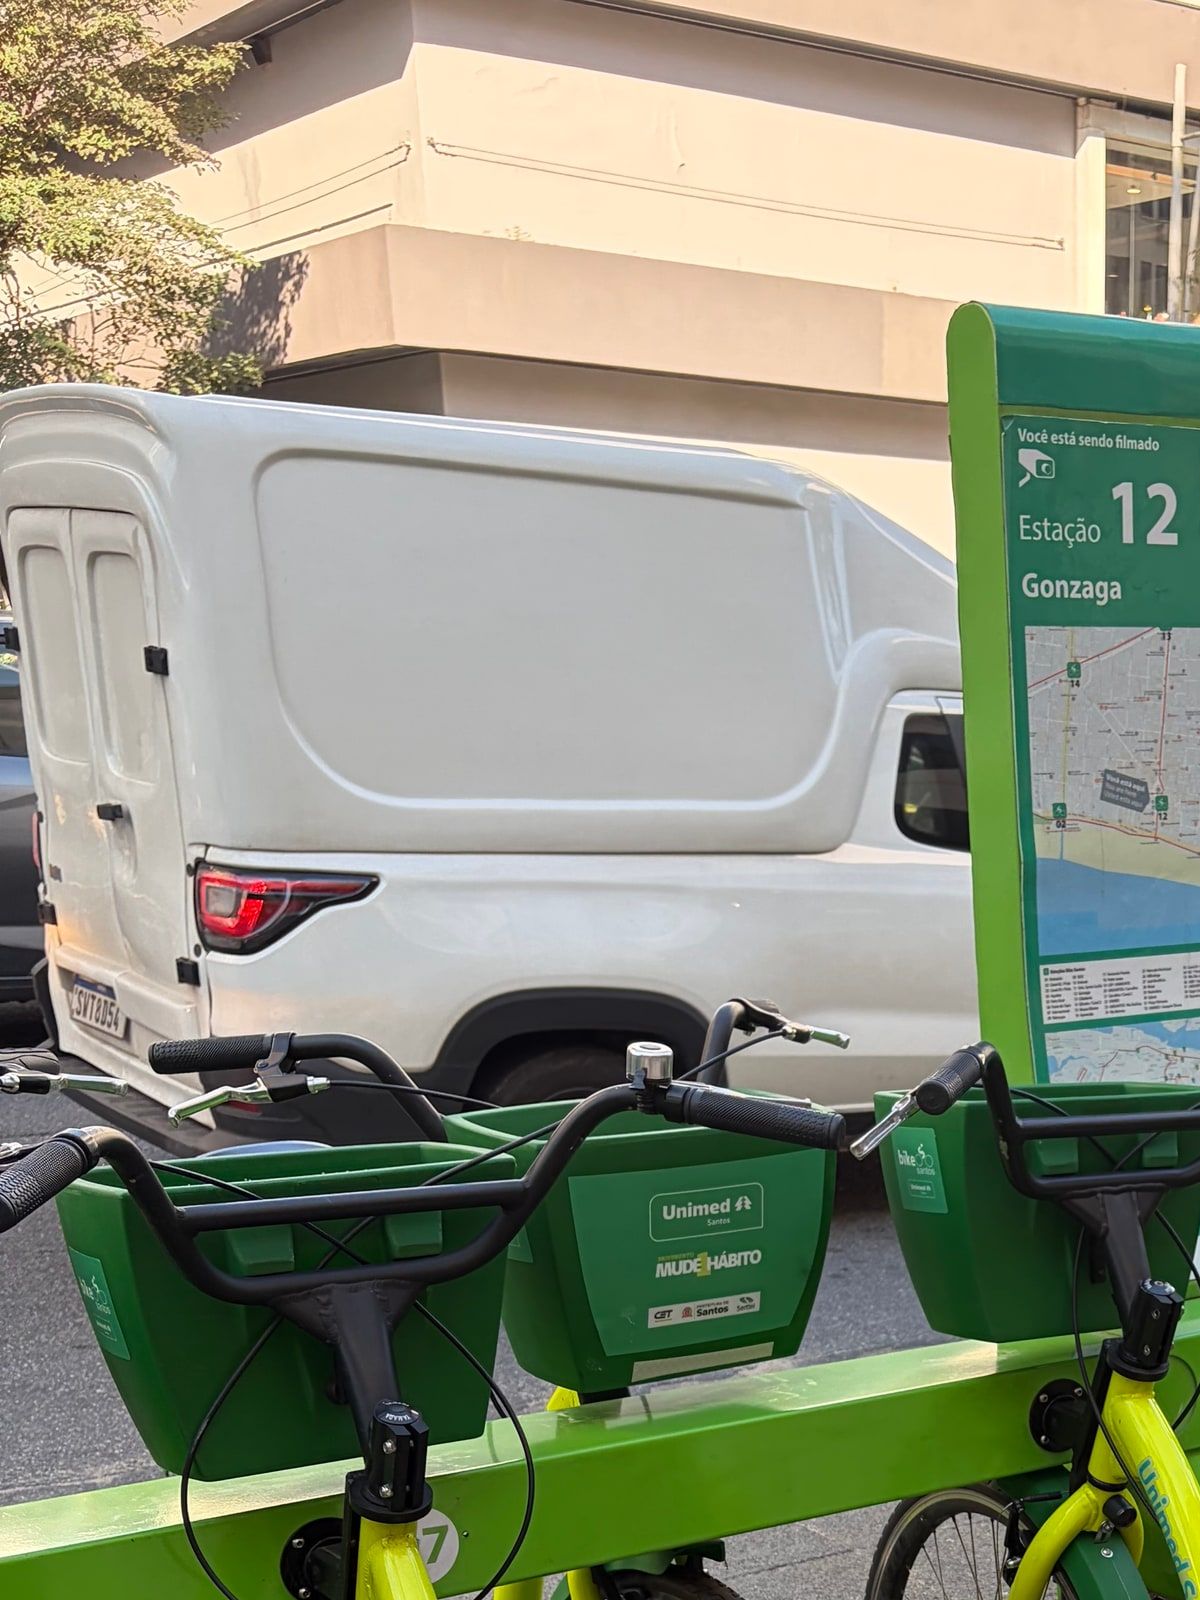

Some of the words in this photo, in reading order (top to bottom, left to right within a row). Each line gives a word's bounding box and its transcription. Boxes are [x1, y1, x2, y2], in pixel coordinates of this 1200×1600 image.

[1018, 428, 1048, 444] Você
[1050, 432, 1076, 446] está
[1078, 434, 1113, 448] sendo
[1115, 435, 1160, 451] filmado
[1112, 482, 1179, 546] 12
[1019, 515, 1101, 549] Estação
[1022, 572, 1122, 606] Gonzaga
[897, 1149, 917, 1167] bike
[662, 1198, 731, 1220] Unimed
[707, 1217, 731, 1227] Santos
[655, 1257, 701, 1278] MUDE
[707, 1250, 762, 1271] HÁBITO
[654, 1309, 673, 1320] CET
[696, 1306, 729, 1317] Santos
[422, 1525, 449, 1564] 7
